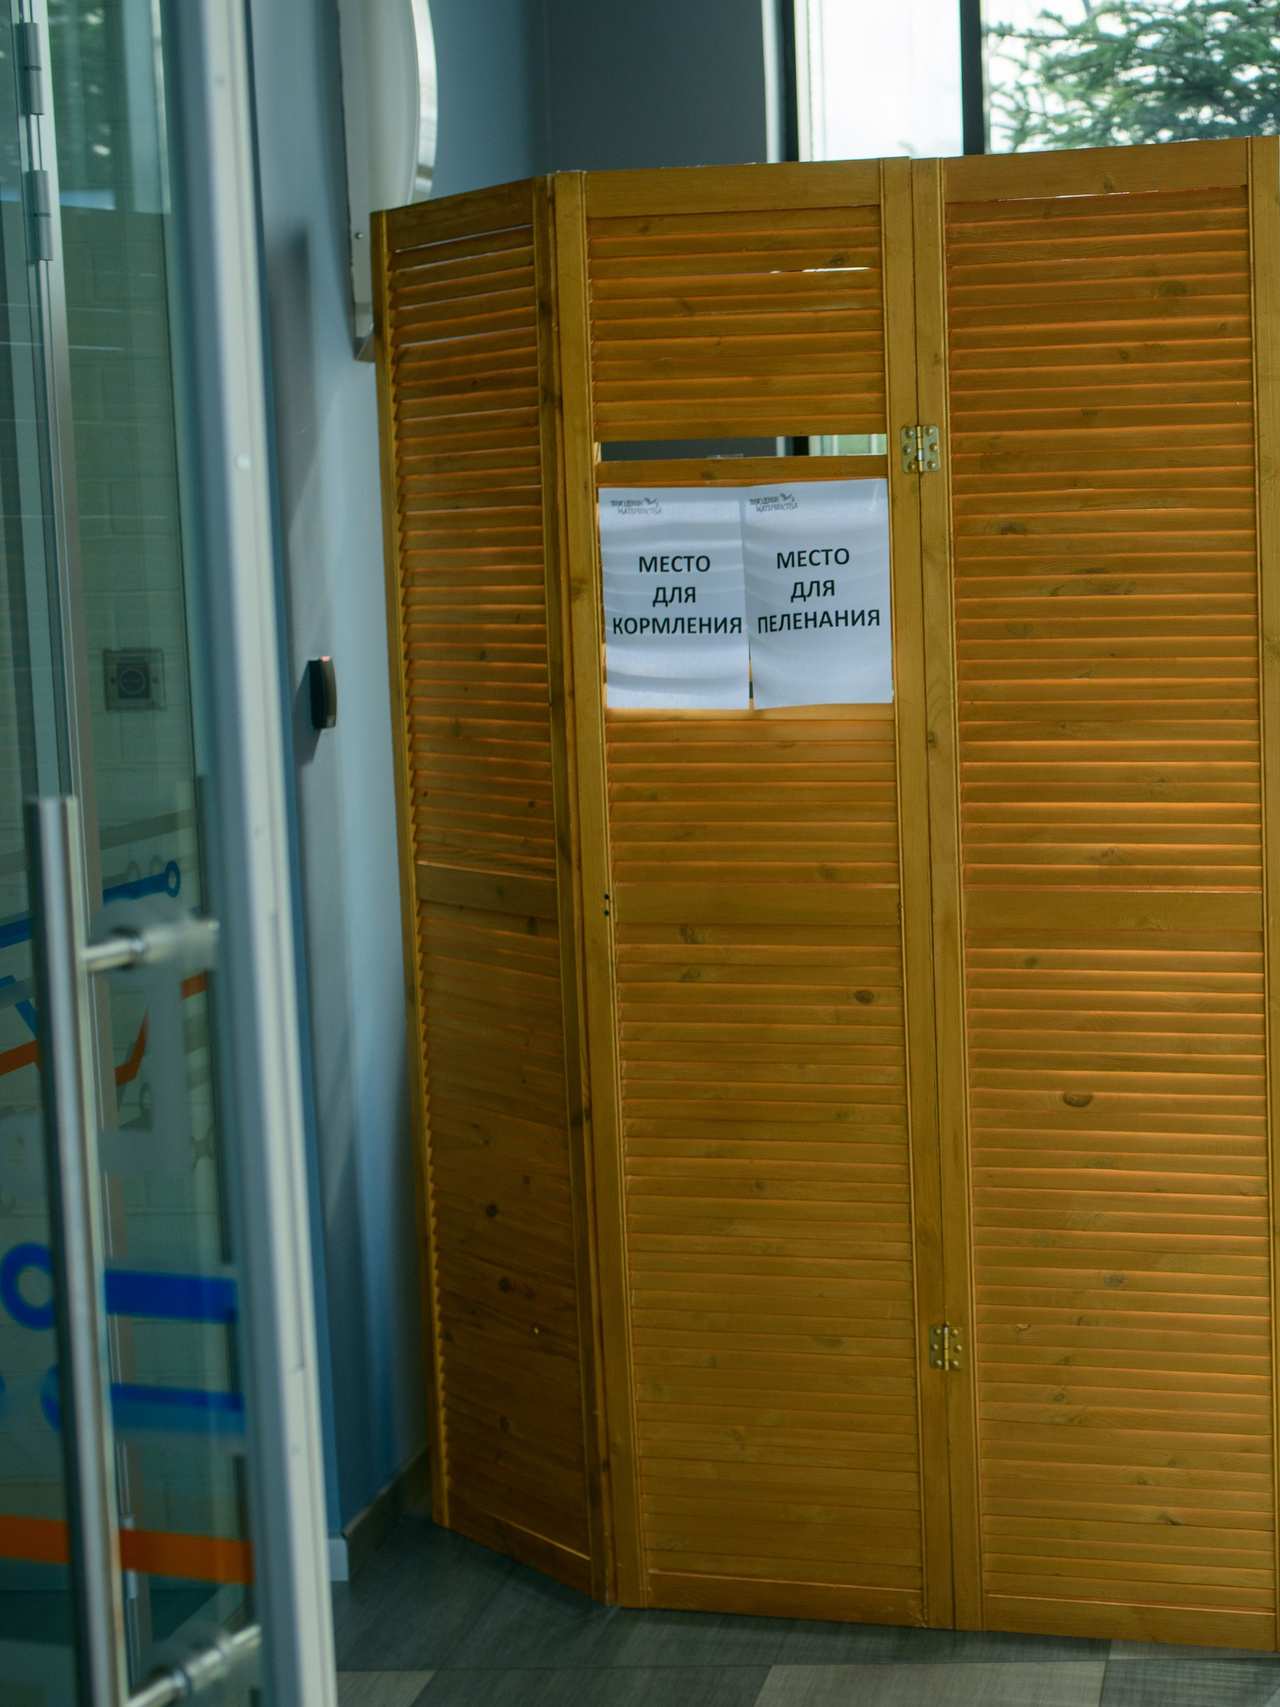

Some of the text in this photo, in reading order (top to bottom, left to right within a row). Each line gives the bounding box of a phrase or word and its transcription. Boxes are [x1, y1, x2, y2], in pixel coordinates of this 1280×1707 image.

[638, 555, 711, 573] МЕСТО
[776, 548, 850, 569] МЕСТО
[652, 586, 697, 607] ДЛЯ
[790, 579, 836, 603] ДЛЯ
[612, 616, 743, 635] КОРМЛЕНИЯ
[756, 609, 881, 634] ПЕЛЕНАНИЯ
